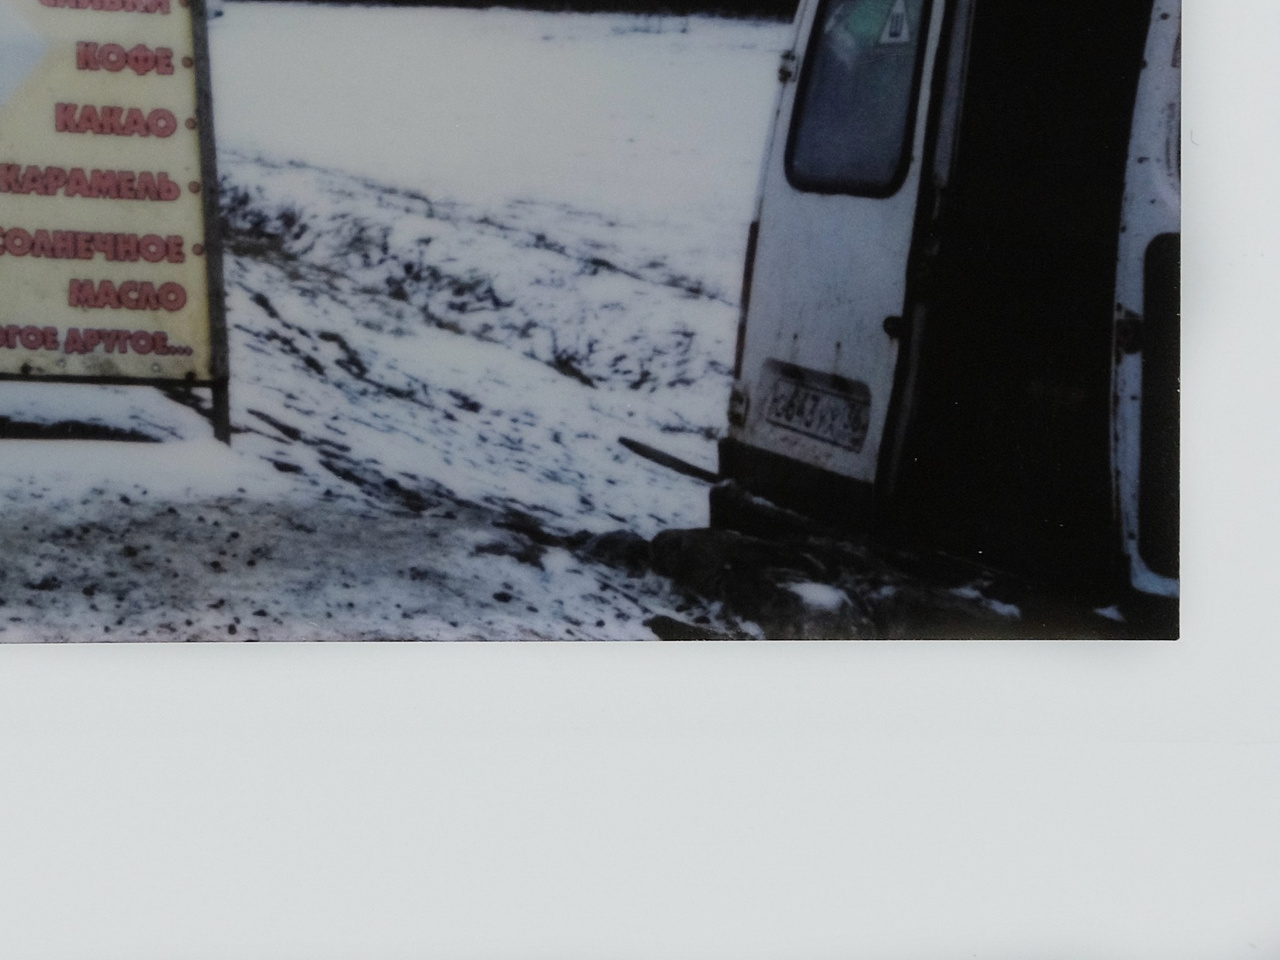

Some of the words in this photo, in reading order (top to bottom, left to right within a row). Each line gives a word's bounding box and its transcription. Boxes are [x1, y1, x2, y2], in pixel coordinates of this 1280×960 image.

[76, 41, 175, 75] КОФЕ
[55, 103, 177, 138] КАКАО
[68, 278, 187, 312] МАСЛО
